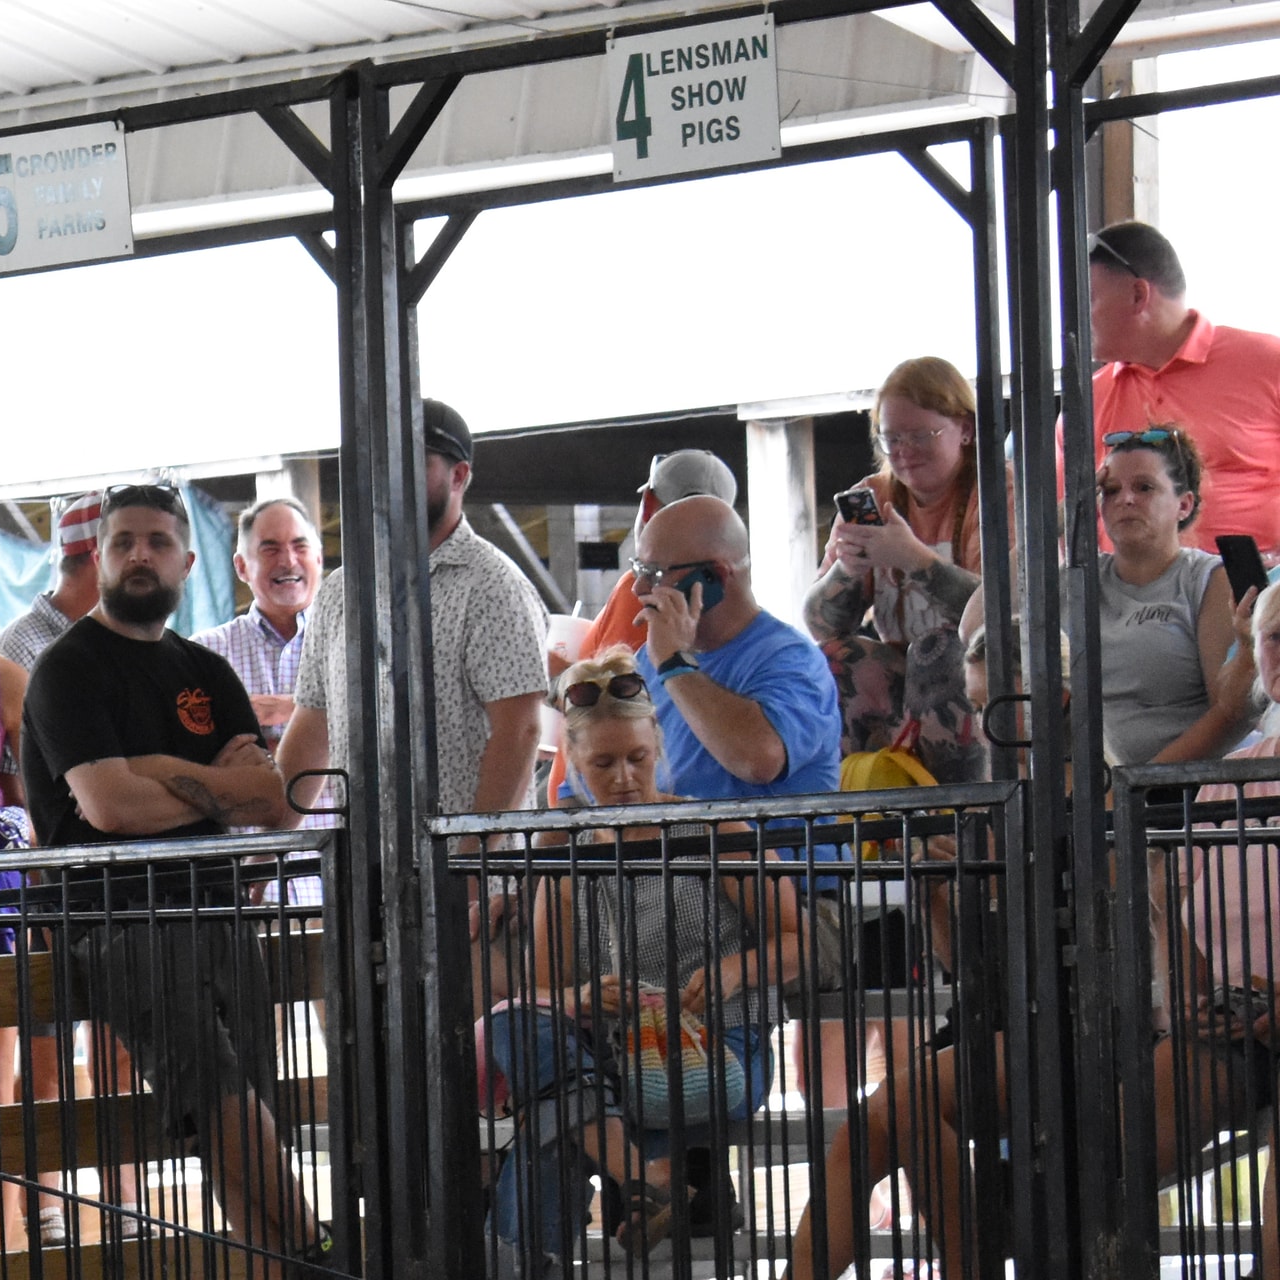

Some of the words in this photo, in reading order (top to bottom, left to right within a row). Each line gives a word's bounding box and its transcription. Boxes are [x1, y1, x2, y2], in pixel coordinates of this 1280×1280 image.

[646, 34, 769, 77] LENSMAN
[615, 53, 652, 159] 4
[671, 76, 747, 111] SHOW
[681, 115, 741, 147] PIGS
[15, 142, 117, 178] CROWDER
[34, 177, 104, 203] FAMLY
[38, 209, 106, 240] FARMS
